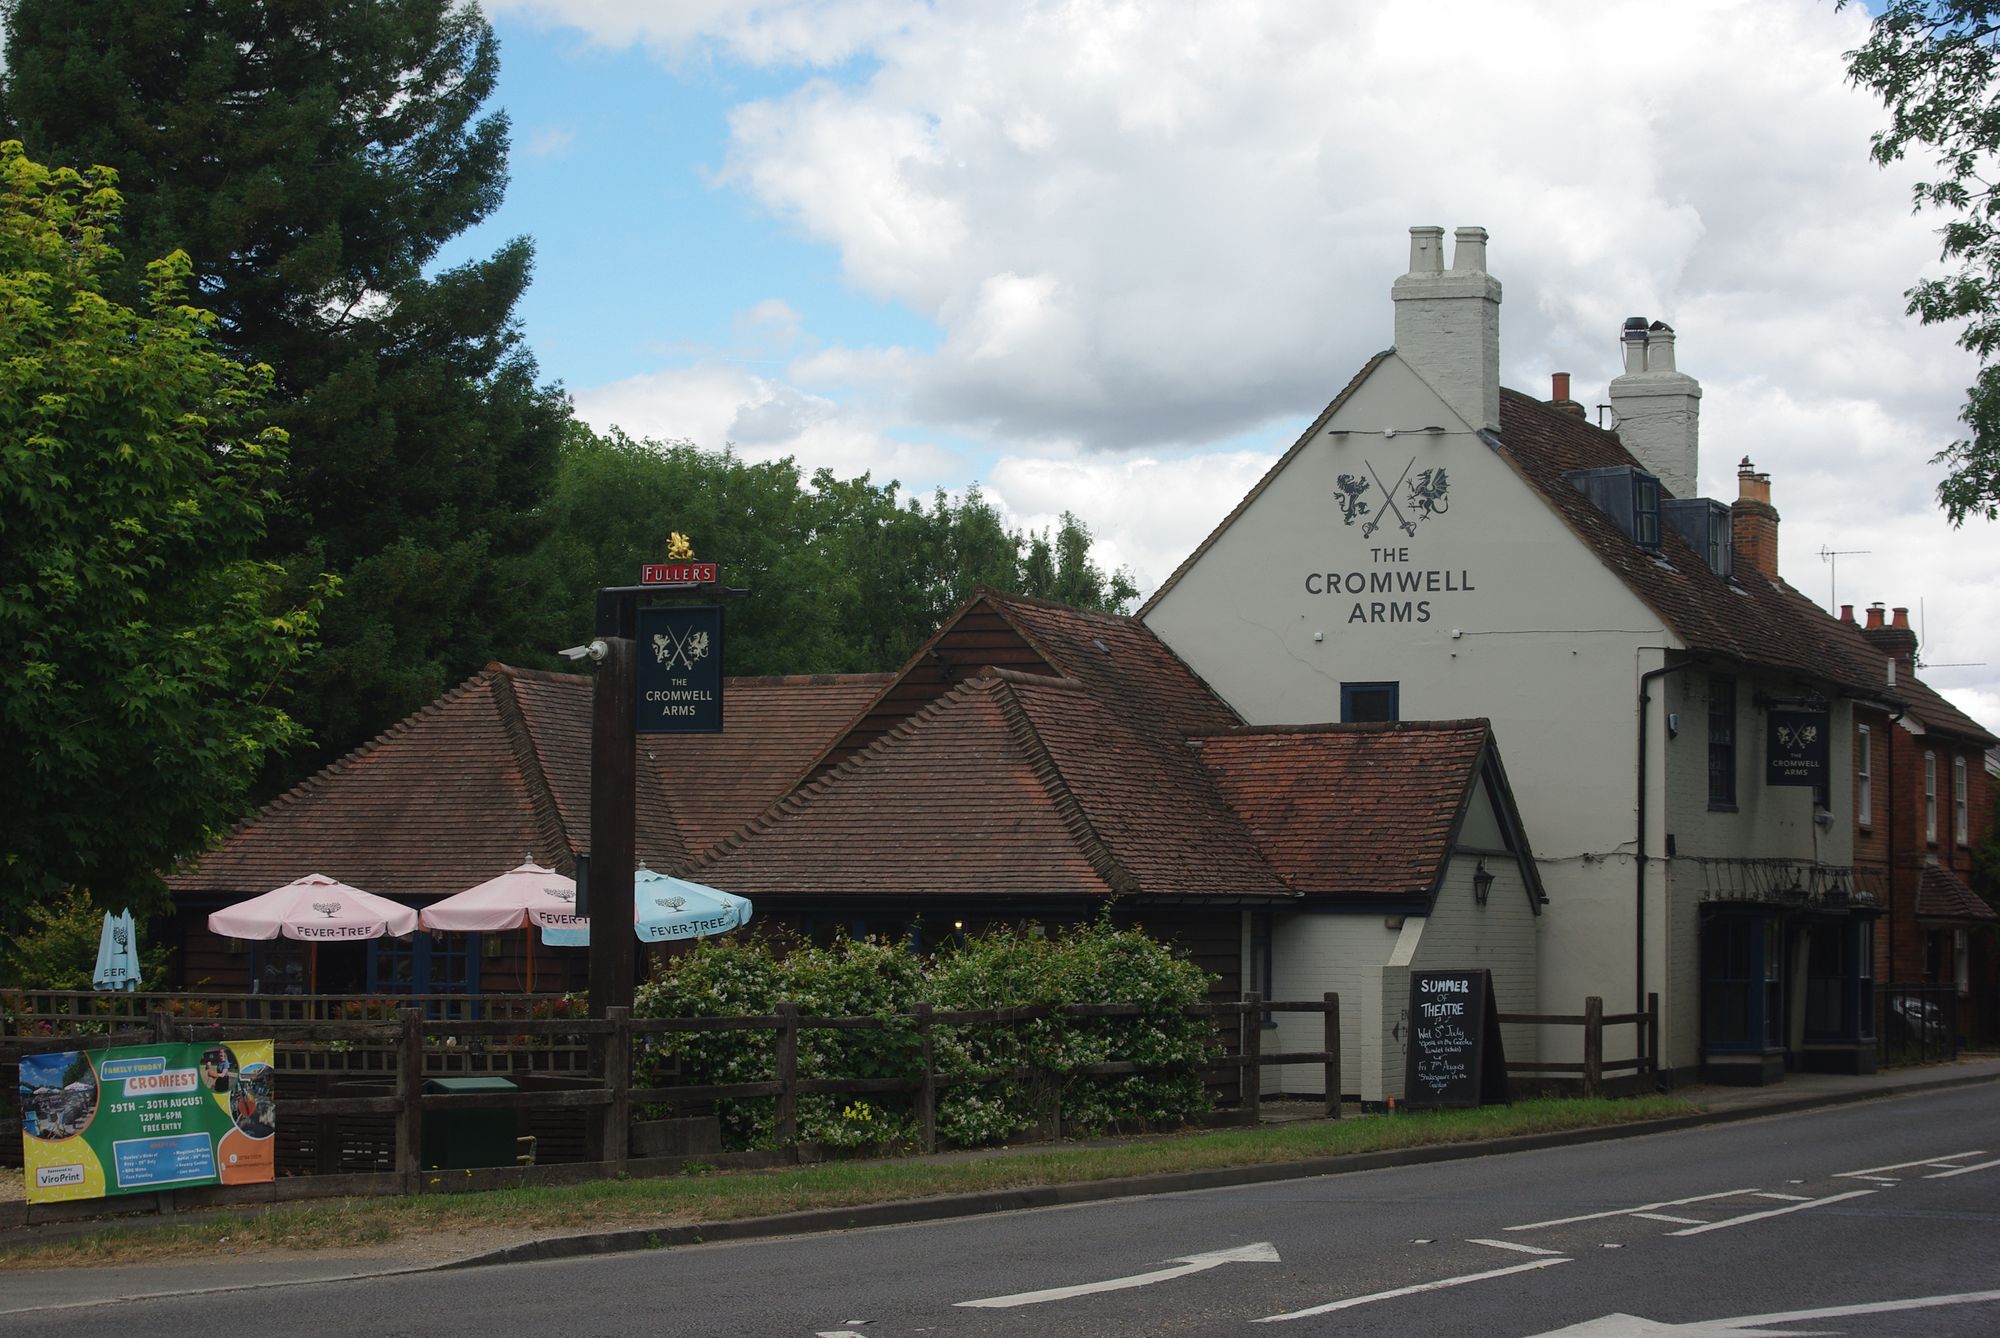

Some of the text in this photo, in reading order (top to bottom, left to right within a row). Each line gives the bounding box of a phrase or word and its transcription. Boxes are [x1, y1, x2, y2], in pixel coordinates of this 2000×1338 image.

[1370, 548, 1409, 563] THE
[1305, 570, 1475, 595] CROMWELL
[1348, 601, 1431, 624] ARMS
[672, 678, 688, 686] THE
[646, 690, 712, 702] CROMWELL
[662, 706, 696, 716] ARMS
[1772, 760, 1820, 768] CROMWELL
[297, 926, 372, 938] FEVER-TREE
[649, 917, 725, 937] FEVER-TREE
[1420, 979, 1470, 993] SUMMER
[1420, 1002, 1464, 1018] THEATRE
[1446, 1025, 1464, 1040] July
[104, 1066, 132, 1075] FAMILY
[129, 1073, 196, 1090] CROMFEST
[110, 1102, 136, 1113] 29TH
[146, 1100, 168, 1110] 30TH
[170, 1096, 203, 1108] AUGUST
[142, 1122, 182, 1133] FREE ENTRY
[41, 1174, 80, 1184] ViroPrint
